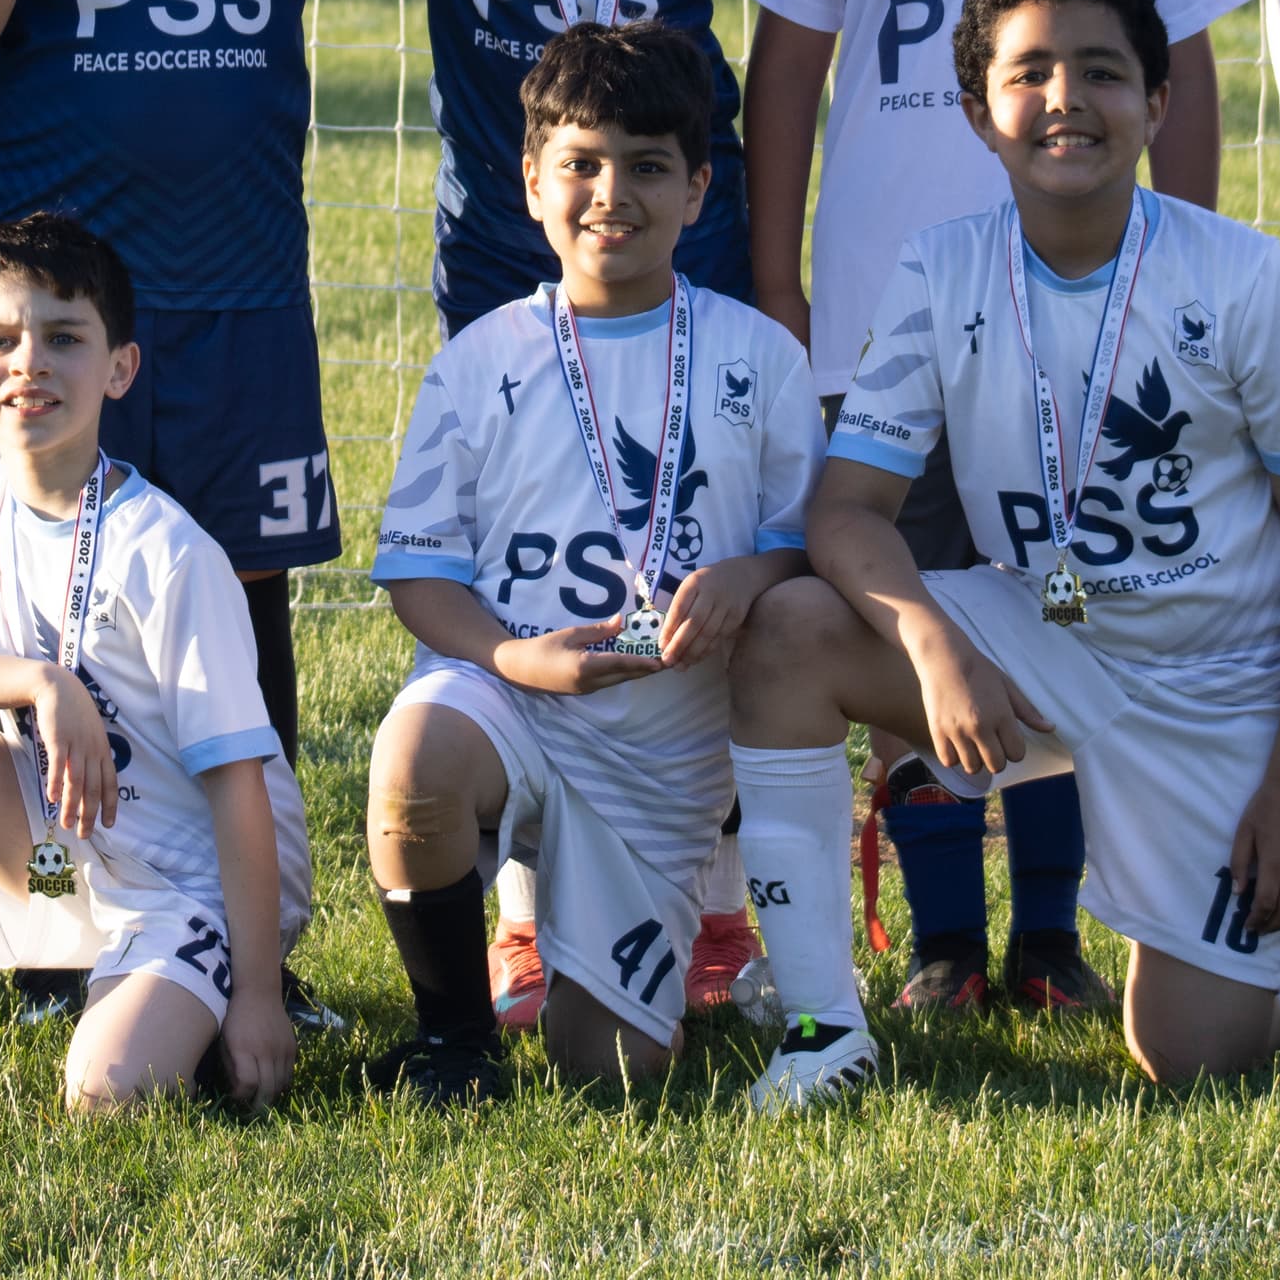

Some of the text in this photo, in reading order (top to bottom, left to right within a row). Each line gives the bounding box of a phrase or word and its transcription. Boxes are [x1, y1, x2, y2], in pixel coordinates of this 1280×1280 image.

[474, 28, 520, 59] PEACE
[73, 48, 267, 72] PEACE SOCCER SCHOOL
[880, 92, 935, 112] PEACE
[676, 307, 687, 337] 2026
[1179, 341, 1209, 359] PSS
[674, 355, 685, 387] 2026
[558, 314, 609, 494] 2026 2026 2026 2026
[720, 399, 750, 418] PSS
[669, 404, 682, 440] 2026
[1040, 399, 1054, 434] 2026
[1047, 456, 1059, 491] 2026
[660, 461, 674, 496] 2026
[652, 516, 667, 551] 2026
[997, 483, 1199, 568] PSS
[70, 585, 83, 620] 2026
[78, 531, 91, 565] 2026
[85, 476, 98, 511] 2026
[1083, 552, 1220, 596] OCCER SCHOOL
[1042, 607, 1085, 622] SOCCER
[28, 878, 76, 894] SOCCER
